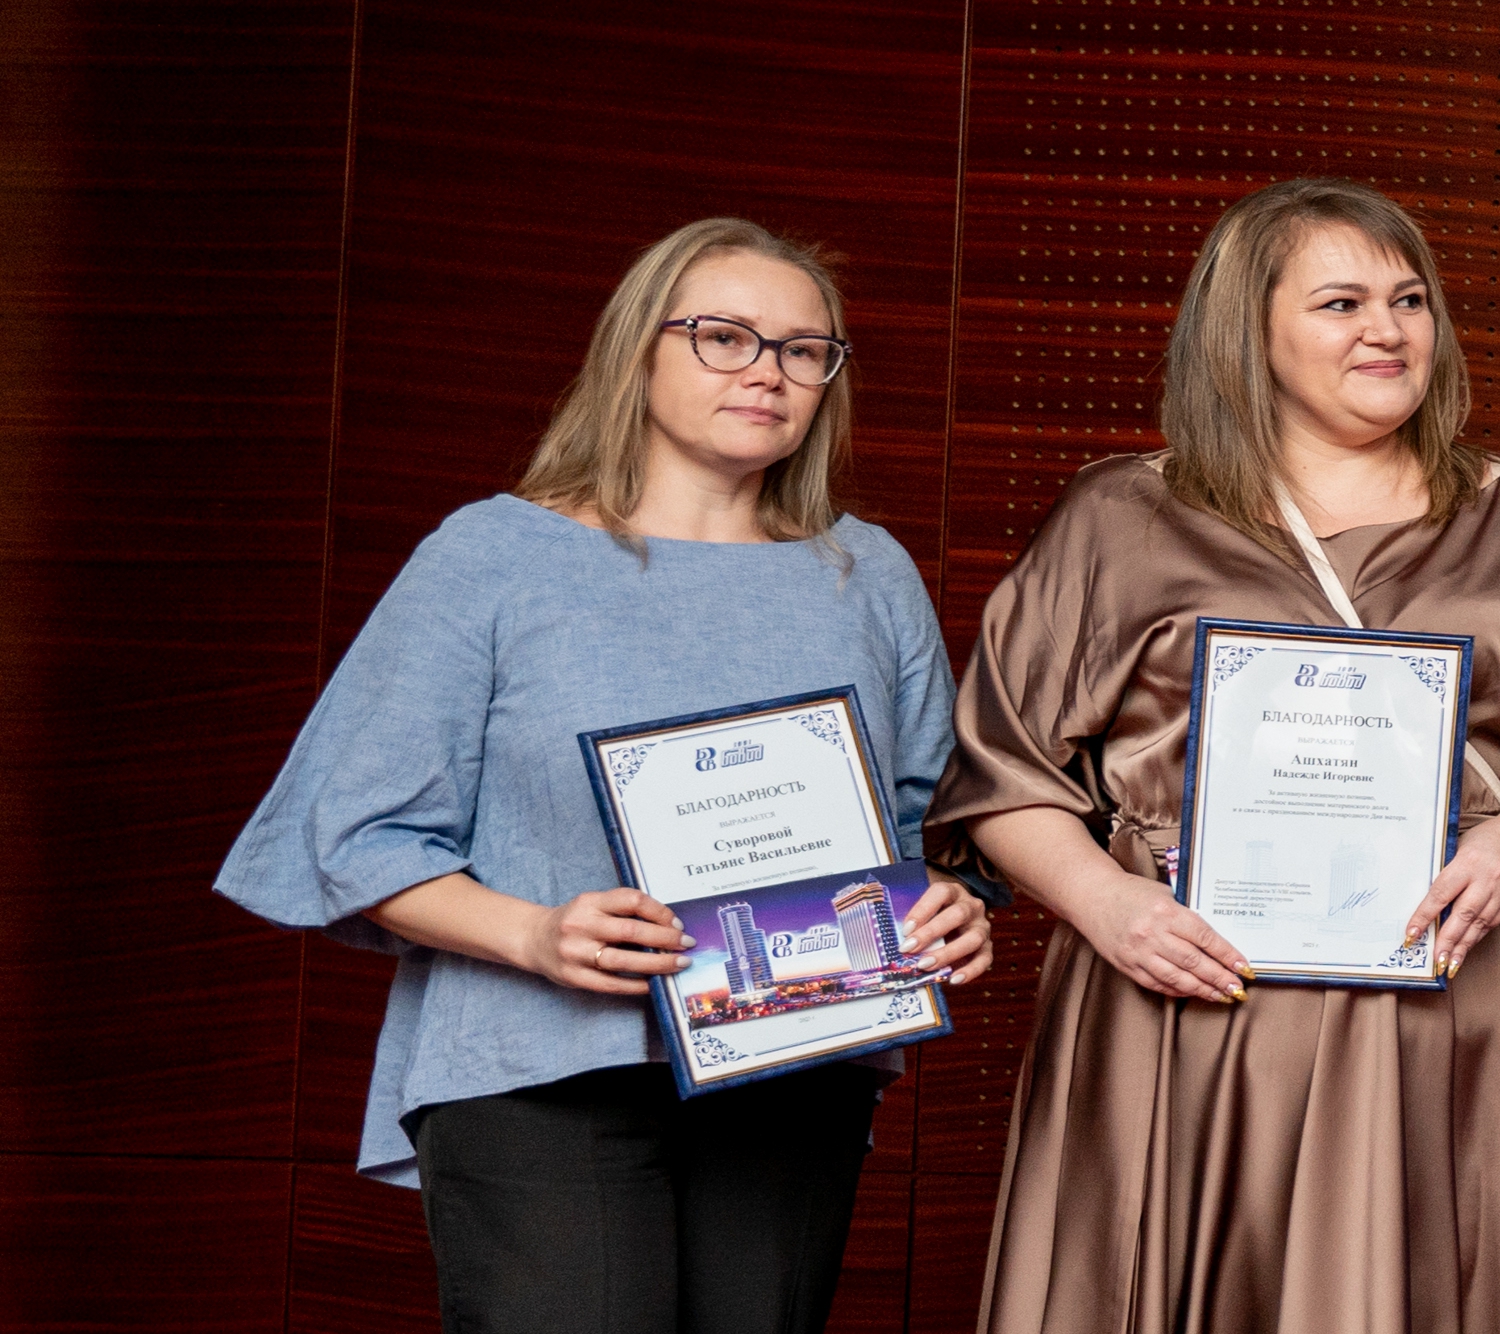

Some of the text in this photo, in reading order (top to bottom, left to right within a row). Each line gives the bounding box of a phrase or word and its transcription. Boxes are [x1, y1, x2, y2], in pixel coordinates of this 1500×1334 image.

[1262, 710, 1394, 729] БЛАГОДАРНОСТЬ
[1273, 768, 1375, 784] Надежде Игоревне
[675, 780, 807, 817] БЛАГОДАРНОСТЬ
[713, 826, 793, 853] Суворовой
[683, 838, 832, 877] Татьяне Васильевне
